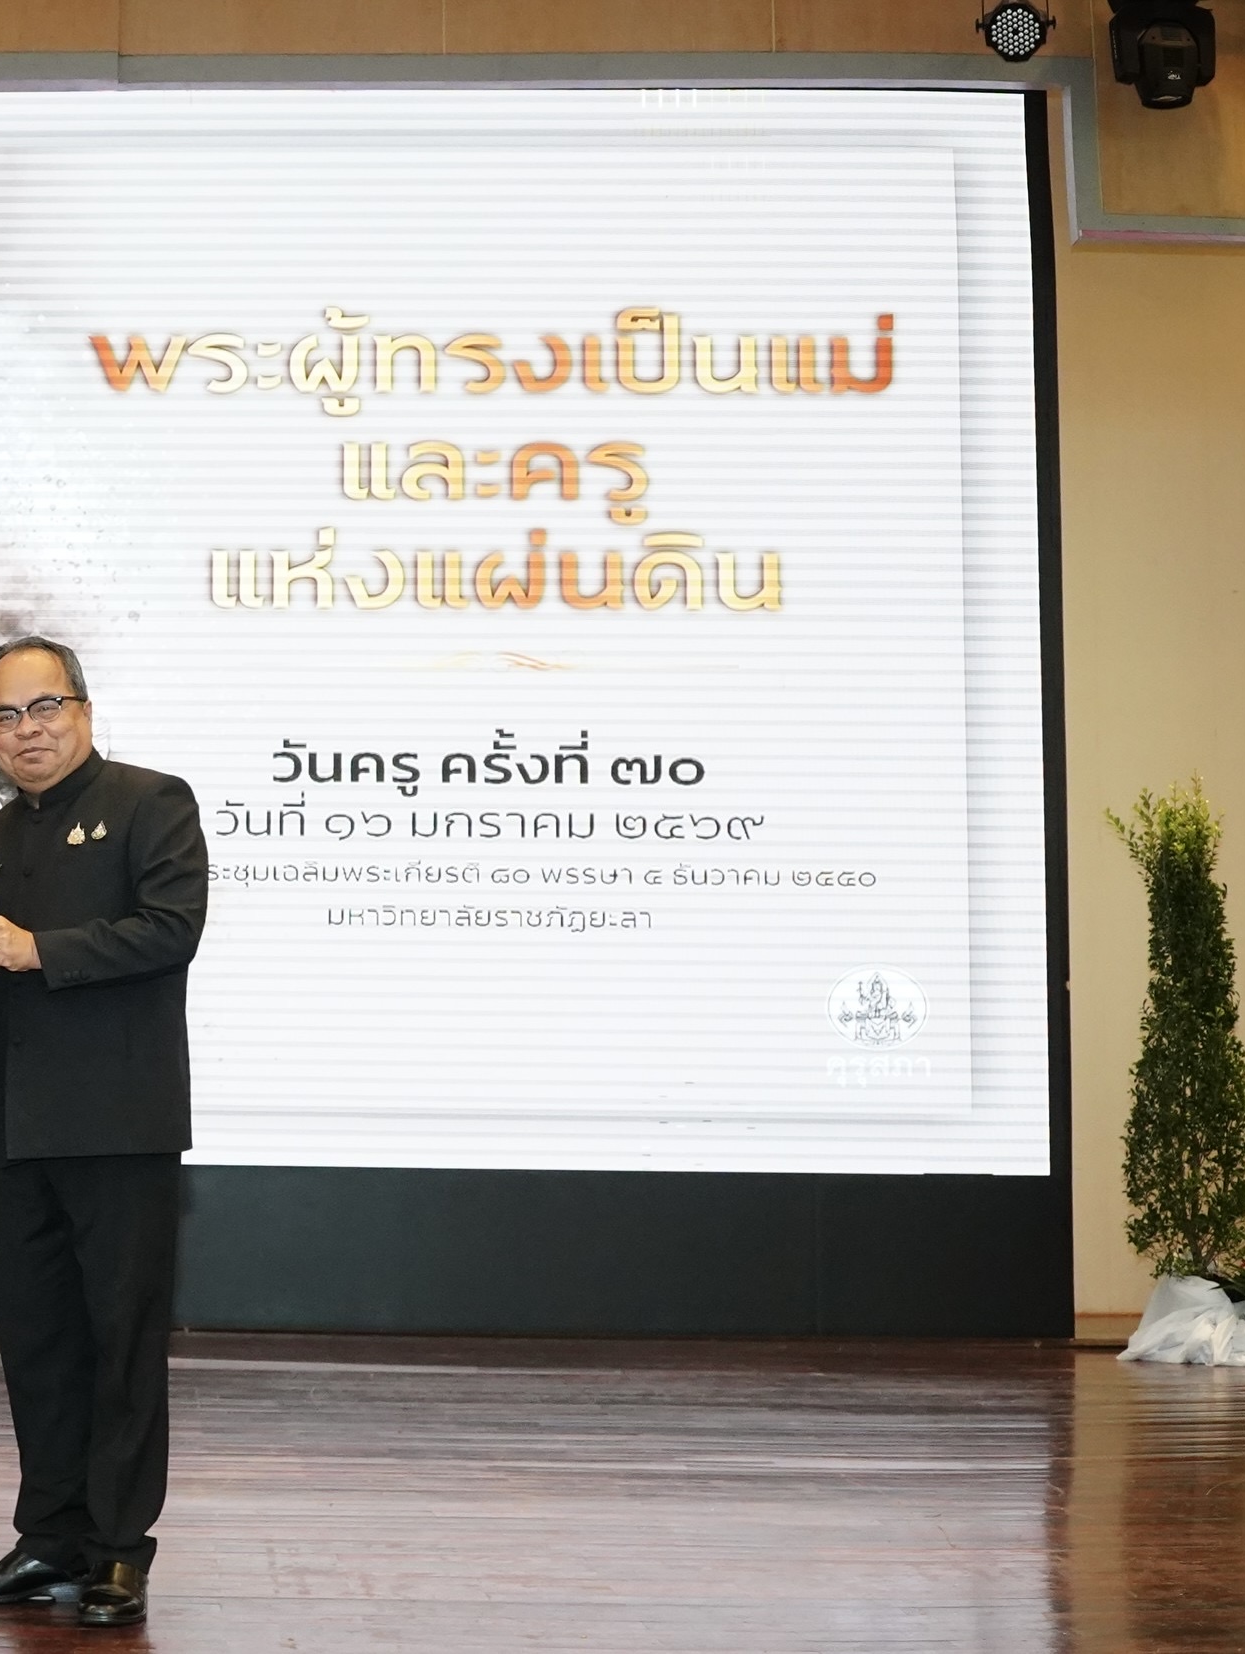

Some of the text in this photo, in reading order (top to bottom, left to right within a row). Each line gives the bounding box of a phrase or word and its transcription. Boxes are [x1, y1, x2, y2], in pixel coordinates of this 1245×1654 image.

[88, 306, 896, 416] พระผู้ทรงเป็นแม่
[341, 440, 649, 525] และครู
[209, 526, 783, 611] แห่งแผ่นดิน
[272, 728, 706, 798] วันครู ครั้งที่ ๗๐
[215, 791, 765, 841] วันที่ ๑๖ มกราคม ๒๕๖๙
[208, 860, 480, 888] ระชุมเฉลิมพระเกียรติ
[541, 867, 633, 886] พรรษา
[673, 862, 781, 887] ธันวาคม
